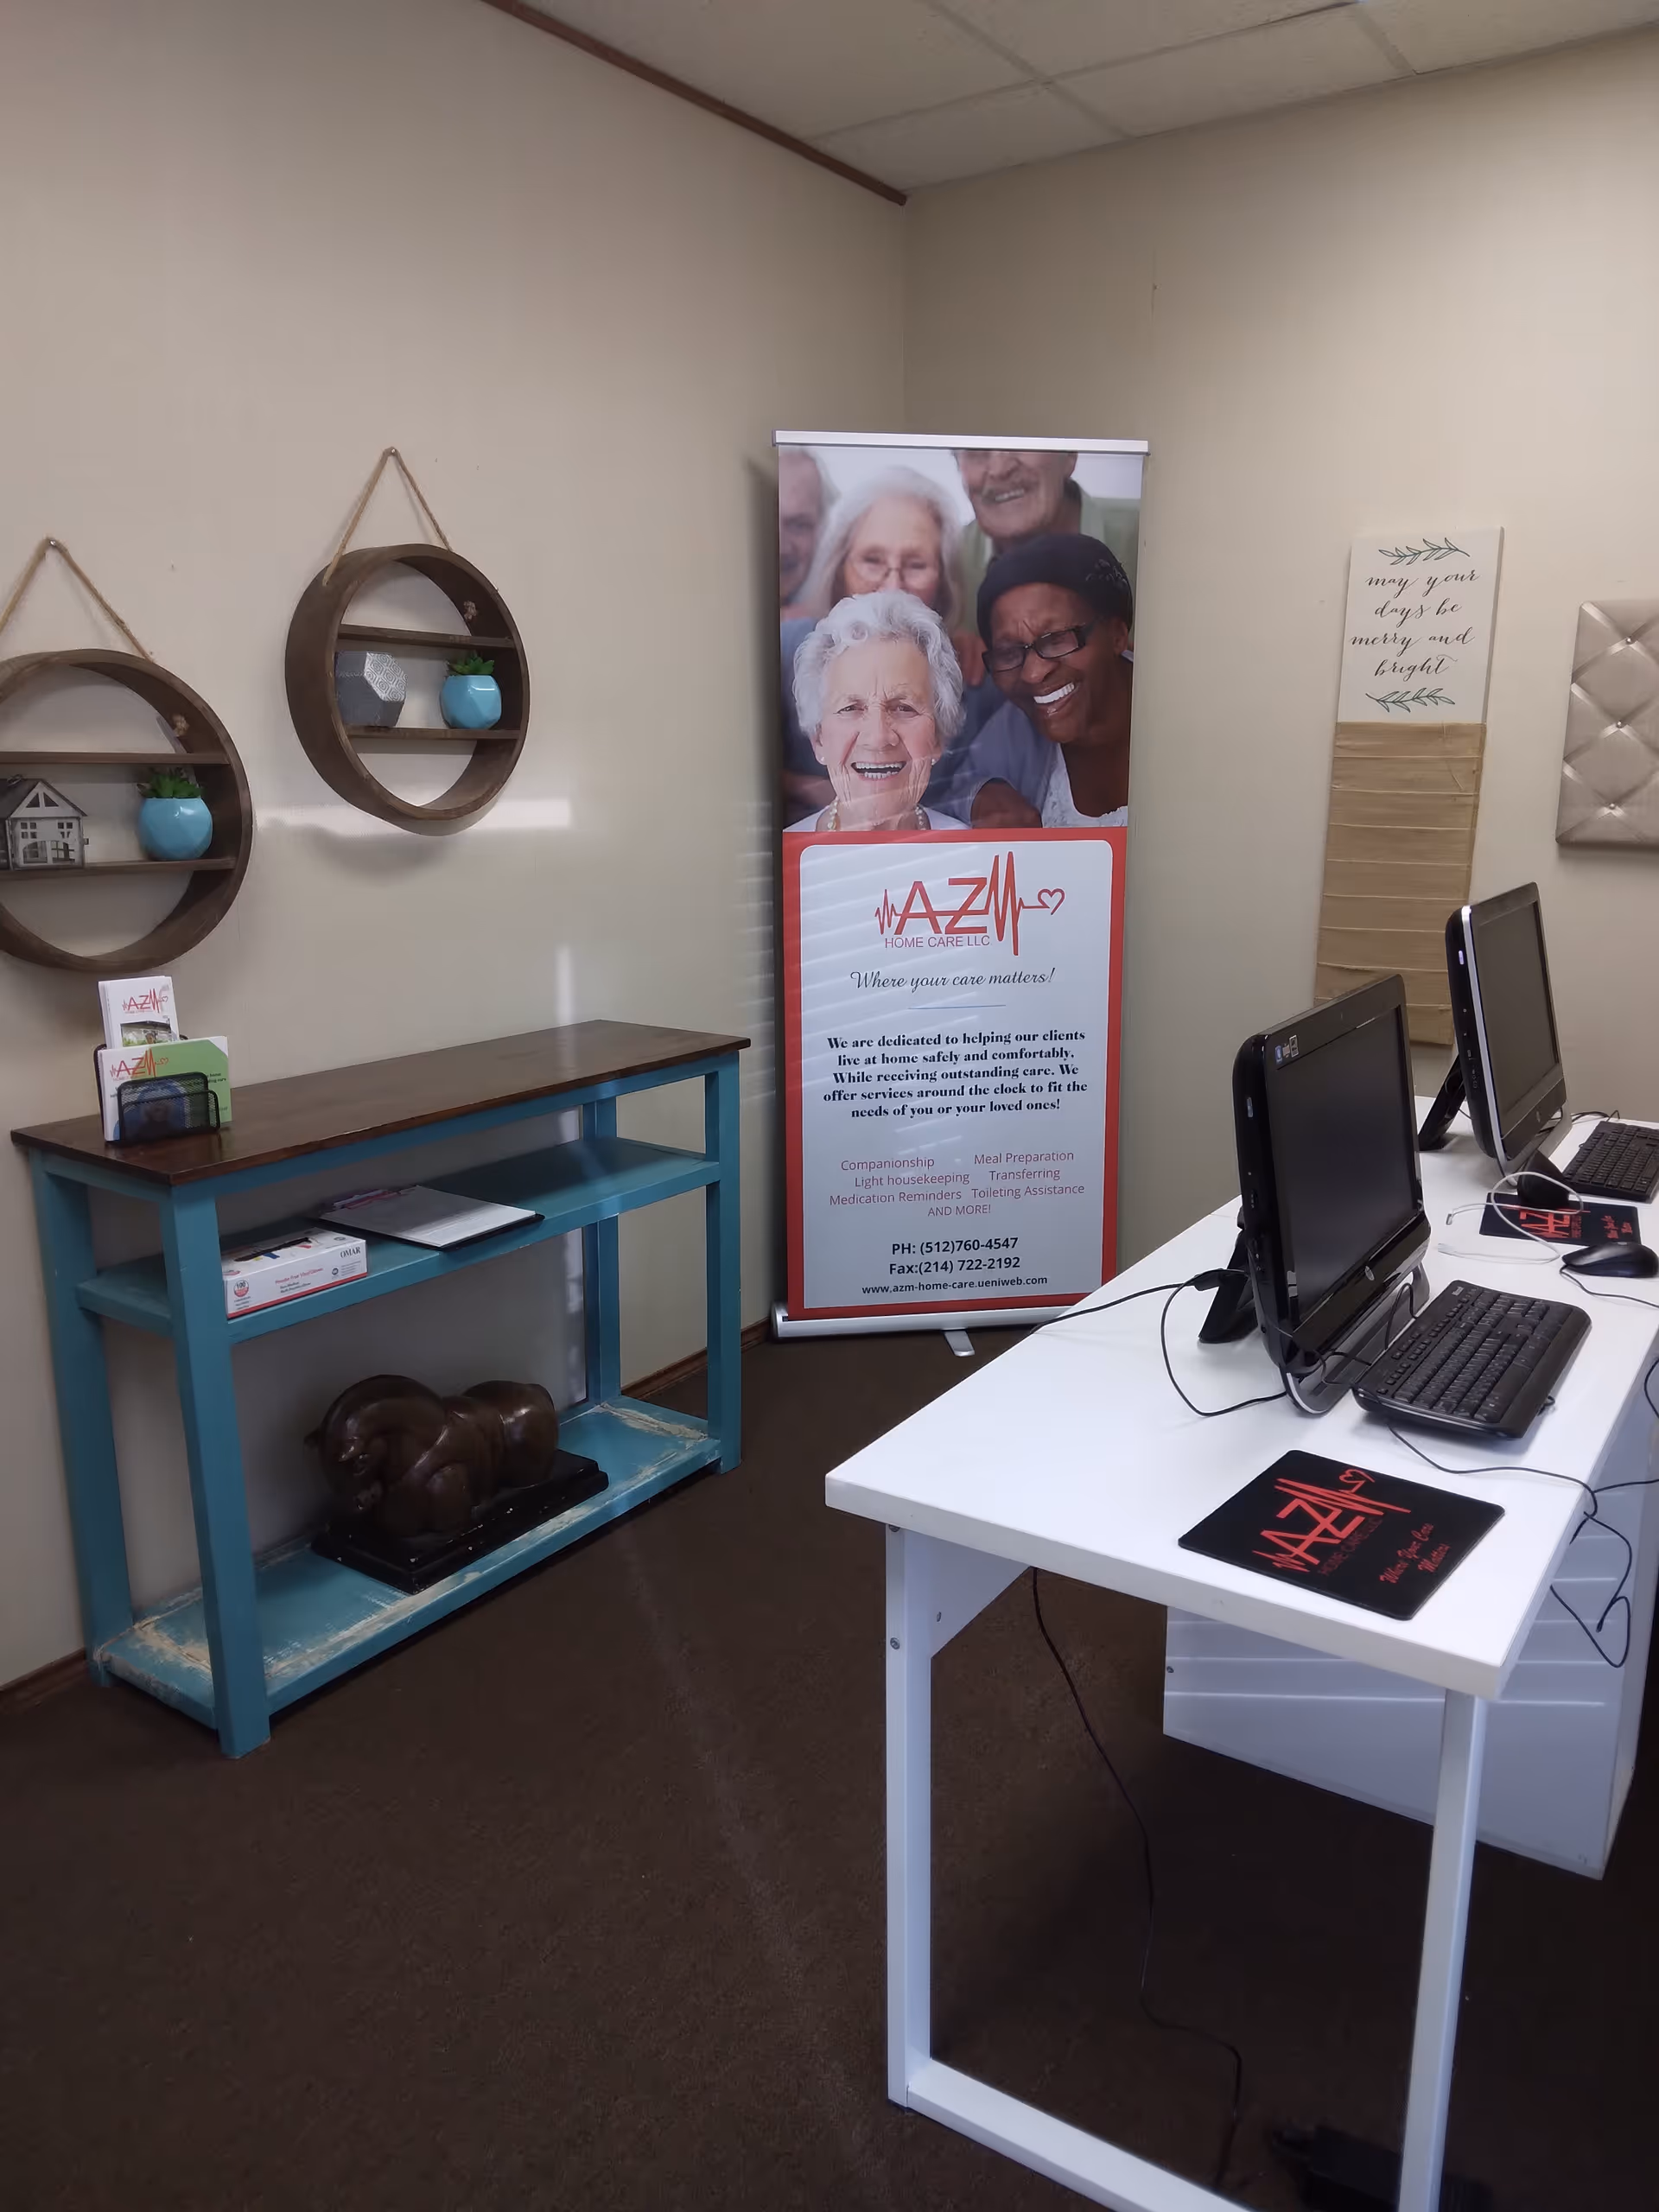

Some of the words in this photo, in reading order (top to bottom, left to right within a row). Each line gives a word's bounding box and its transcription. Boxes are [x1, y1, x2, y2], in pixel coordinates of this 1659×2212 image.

[1365, 577, 1419, 599] may
[1422, 569, 1480, 597] your
[1375, 601, 1431, 628] days
[1436, 598, 1462, 615] be
[1351, 632, 1424, 657] merry
[1428, 627, 1475, 645] and
[1375, 654, 1458, 682] bright
[885, 938, 924, 948] HOME
[928, 937, 963, 947] CARE
[850, 970, 907, 988] Where
[911, 976, 950, 993] your
[952, 975, 986, 986] care
[988, 968, 1056, 984] matters!
[827, 1037, 848, 1049] We
[852, 1039, 874, 1047] are
[878, 1034, 941, 1047] dedicated
[945, 1034, 958, 1045] to
[963, 1032, 1011, 1046] helping
[1014, 1033, 1039, 1042] our
[1042, 1030, 1085, 1041] clients
[837, 1055, 860, 1066] live
[864, 1055, 878, 1065] at
[881, 1053, 918, 1065] home
[923, 1052, 960, 1065] safely
[964, 1050, 988, 1061] and
[833, 1071, 872, 1084] While
[876, 1070, 938, 1083] receiving
[941, 1065, 1019, 1079] outstanding
[1022, 1065, 1055, 1076] care.
[1059, 1064, 1078, 1076] We
[823, 1090, 857, 1102] offer
[861, 1089, 913, 1100] services
[917, 1086, 964, 1098] around
[969, 1084, 990, 1096] the
[994, 1083, 1027, 1095] clock
[1030, 1083, 1043, 1093] to
[1047, 1081, 1063, 1092] fit
[1066, 1080, 1087, 1092] the
[851, 1106, 889, 1118] needs
[893, 1104, 908, 1116] of
[910, 1105, 933, 1118] you
[938, 1104, 953, 1115] or
[956, 1103, 985, 1116] your
[989, 1100, 1022, 1112] loved
[1026, 1099, 1060, 1110] ones!
[841, 1157, 935, 1172] Companionship
[974, 1154, 1002, 1165] Meal
[1006, 1151, 1074, 1166] Preparation
[855, 1177, 883, 1189] Light
[887, 1173, 969, 1189] housekeeping
[989, 1168, 1060, 1182] Transferring
[830, 1193, 895, 1205] Medication
[899, 1190, 962, 1203] Reminders
[971, 1187, 1020, 1199] Toileting
[1025, 1185, 1085, 1196] Assistance
[928, 1206, 952, 1217] AND
[956, 1205, 991, 1215] MORE!
[340, 1246, 361, 1259] OMAR
[892, 1243, 916, 1255] PH:
[920, 1237, 1019, 1255] (512)760-4547
[890, 1260, 953, 1274] Fax:(214)
[957, 1257, 1020, 1271] 722-2192
[862, 1276, 1047, 1294] www.azm-home-care.ueniweb.com
